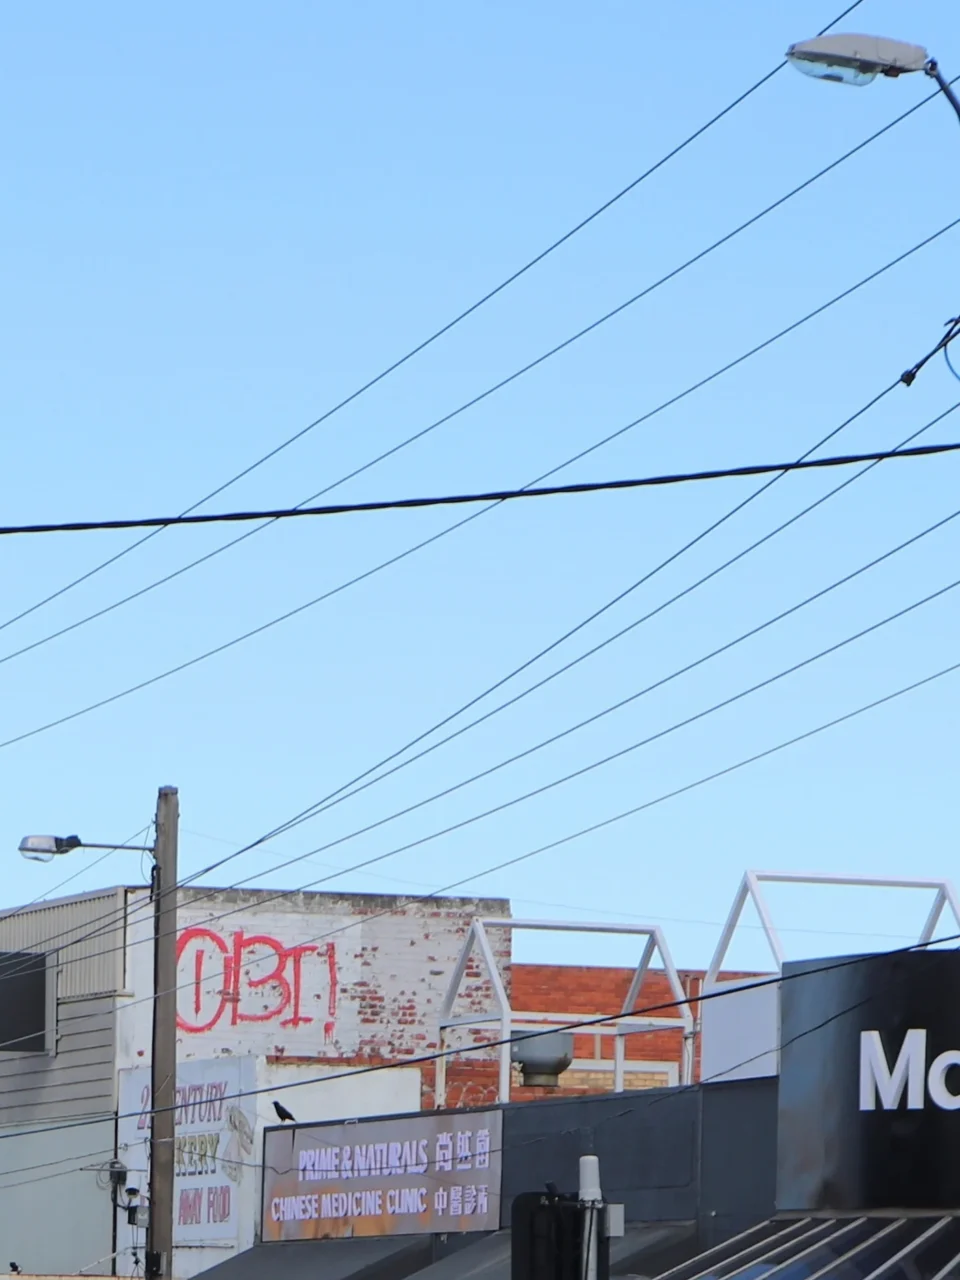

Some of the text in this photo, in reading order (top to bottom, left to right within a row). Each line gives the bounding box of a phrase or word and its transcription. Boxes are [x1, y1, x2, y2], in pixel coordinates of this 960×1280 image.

[858, 1027, 960, 1111] Mc
[175, 1081, 228, 1125] ENTURY
[298, 1147, 339, 1182] PRIME
[354, 1138, 428, 1179] NATURALS
[271, 1187, 427, 1222] CHINESE MEDICINE CLINIC
